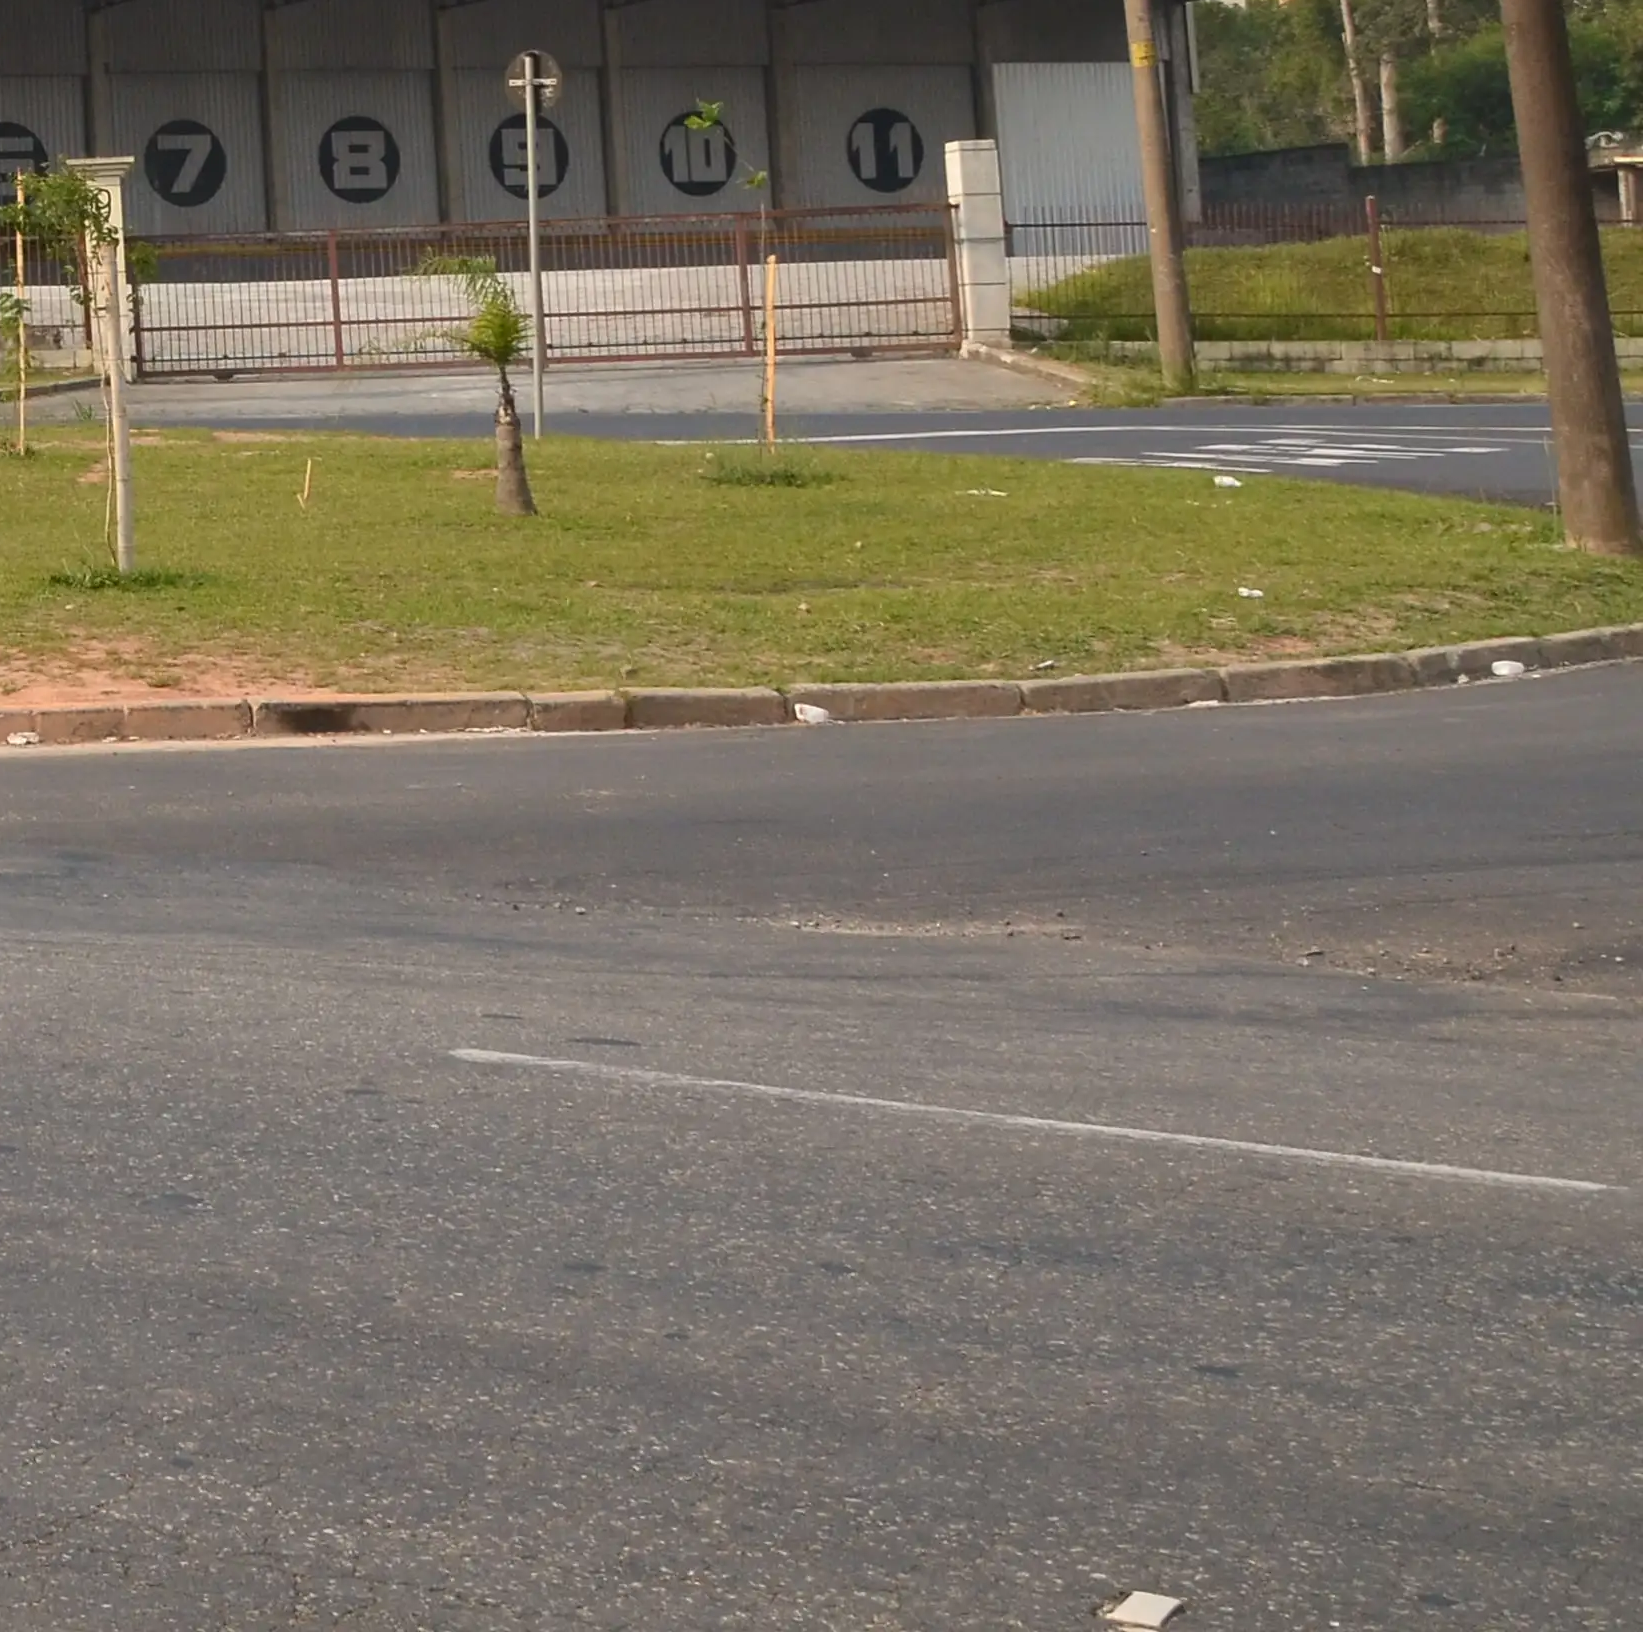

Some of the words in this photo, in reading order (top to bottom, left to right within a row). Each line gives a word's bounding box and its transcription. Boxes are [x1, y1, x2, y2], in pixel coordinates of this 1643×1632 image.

[157, 134, 213, 194] 7
[331, 130, 388, 190] 8
[500, 128, 557, 186] 9
[664, 125, 727, 183] 10
[851, 122, 915, 180] 11
